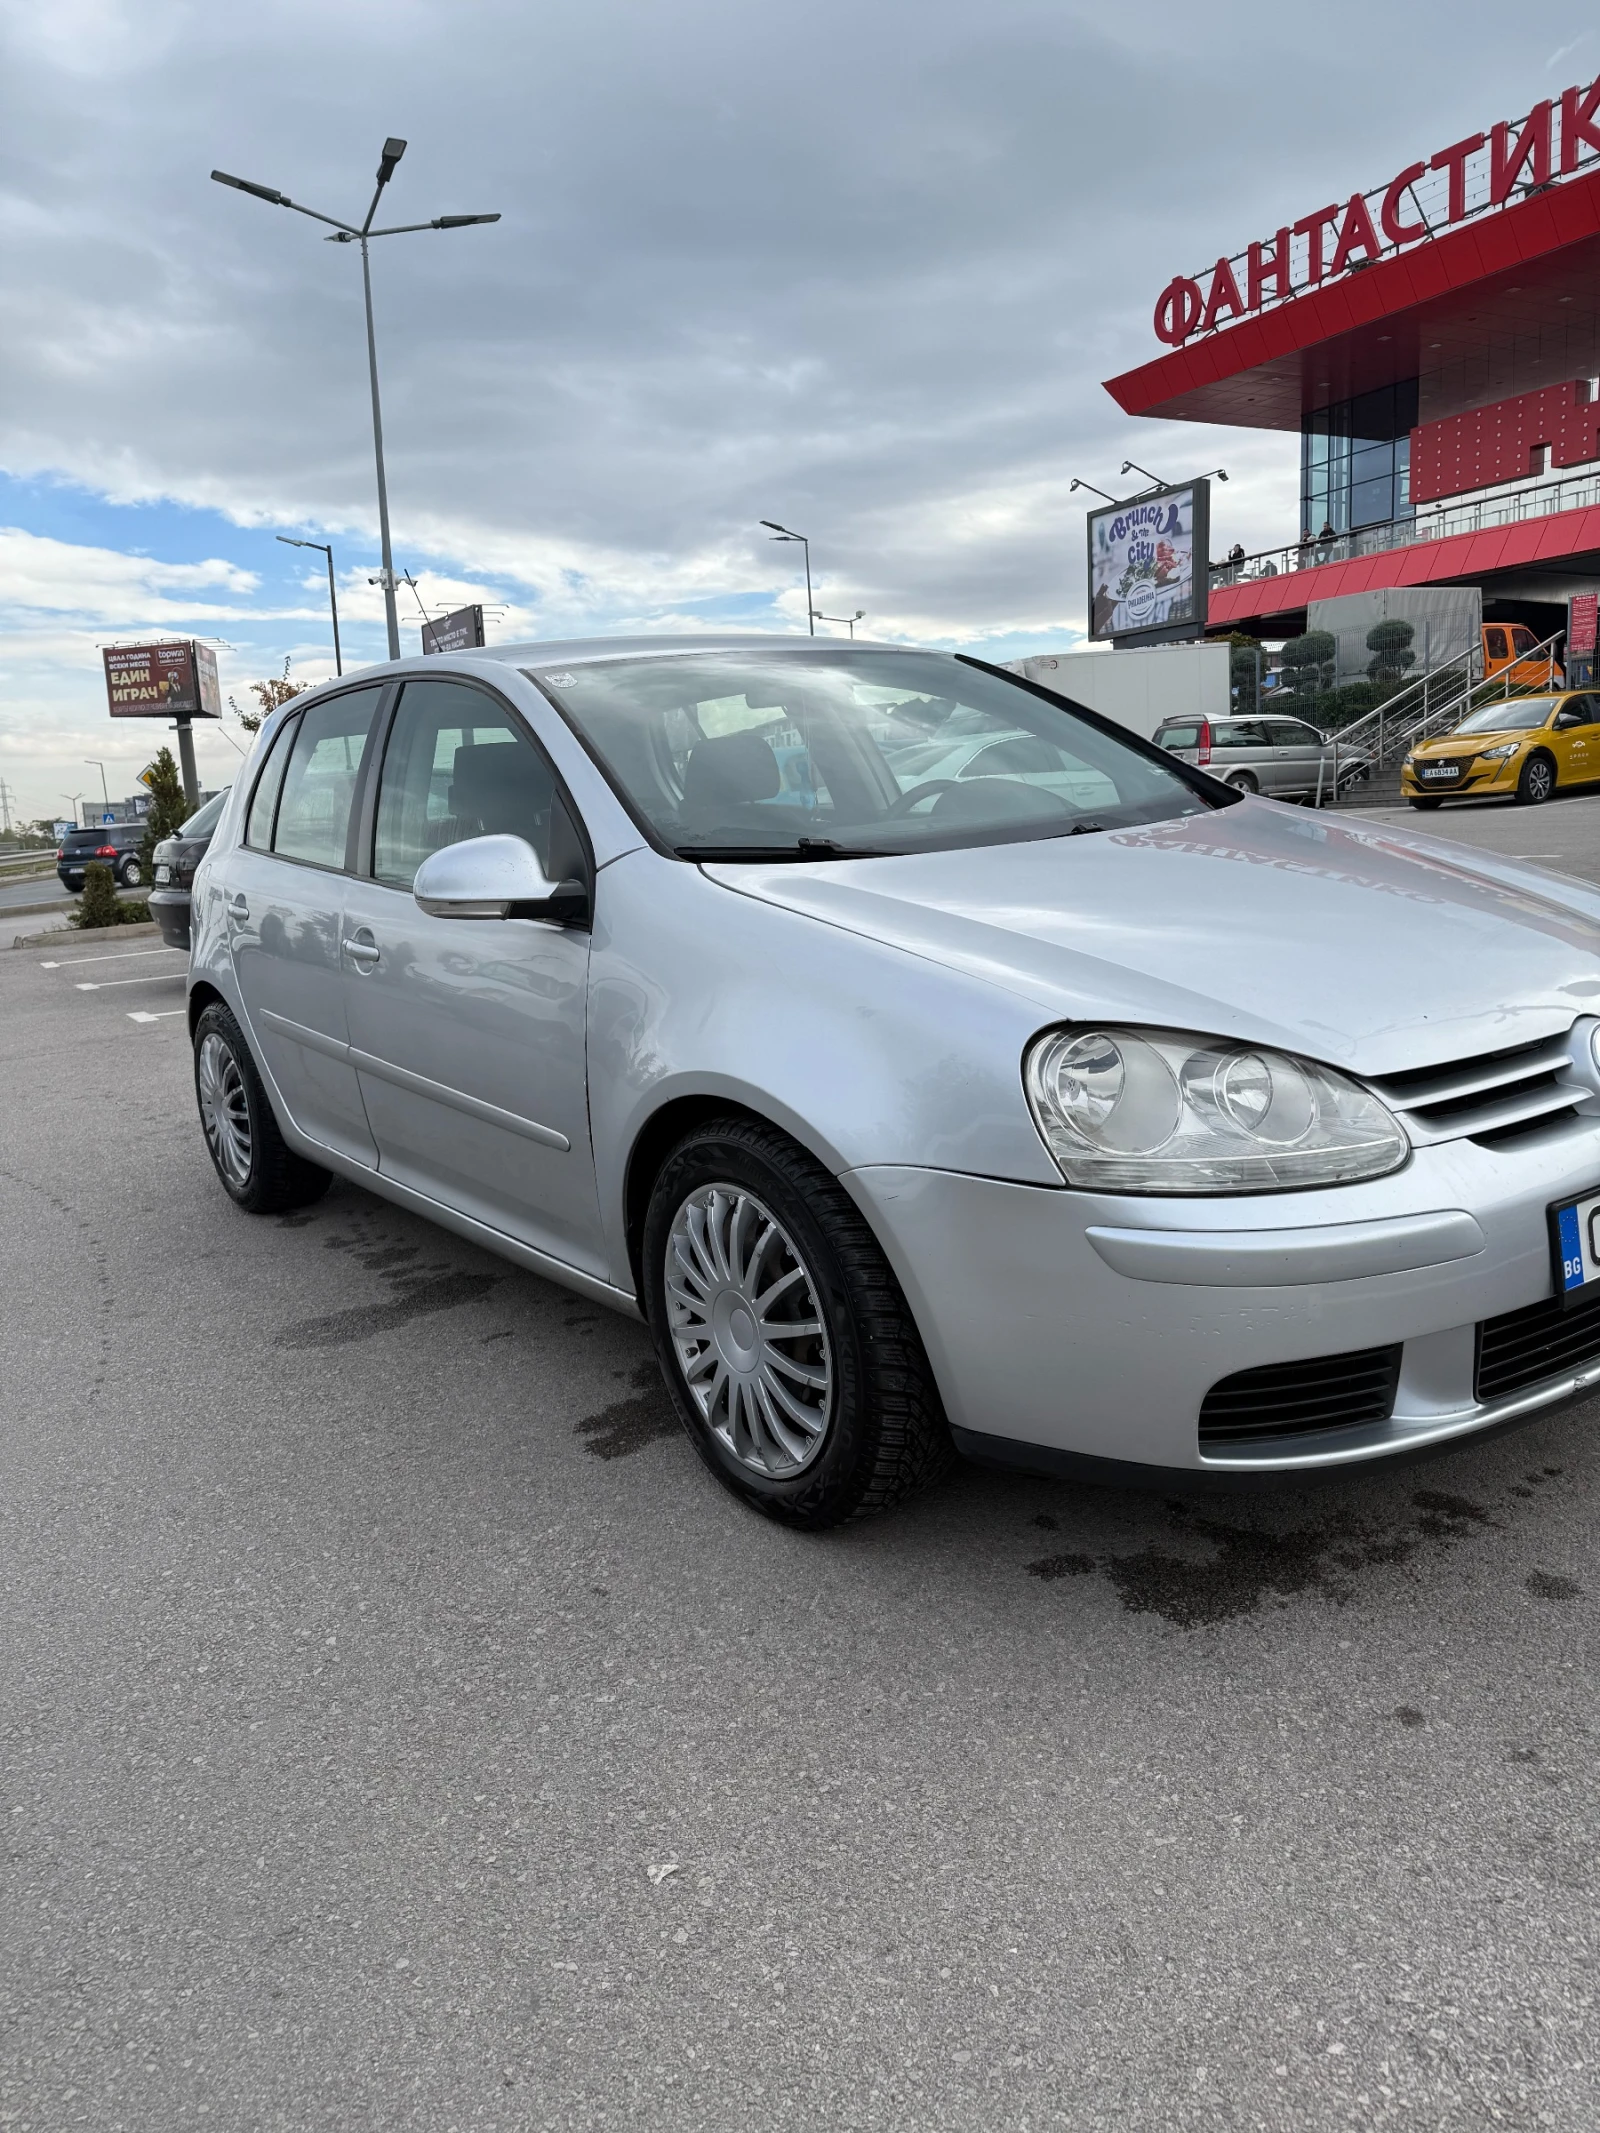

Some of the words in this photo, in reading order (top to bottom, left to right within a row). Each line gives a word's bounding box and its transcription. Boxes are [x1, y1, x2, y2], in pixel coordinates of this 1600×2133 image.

[1154, 73, 1600, 348] ФАНТАСТИК
[1109, 503, 1179, 543] Brunch
[126, 652, 151, 660] ГОДИНА
[158, 650, 184, 659] topwin
[110, 669, 150, 685] ЕДИН
[112, 686, 158, 702] ИГРАЧ
[1563, 1256, 1582, 1280] BG
